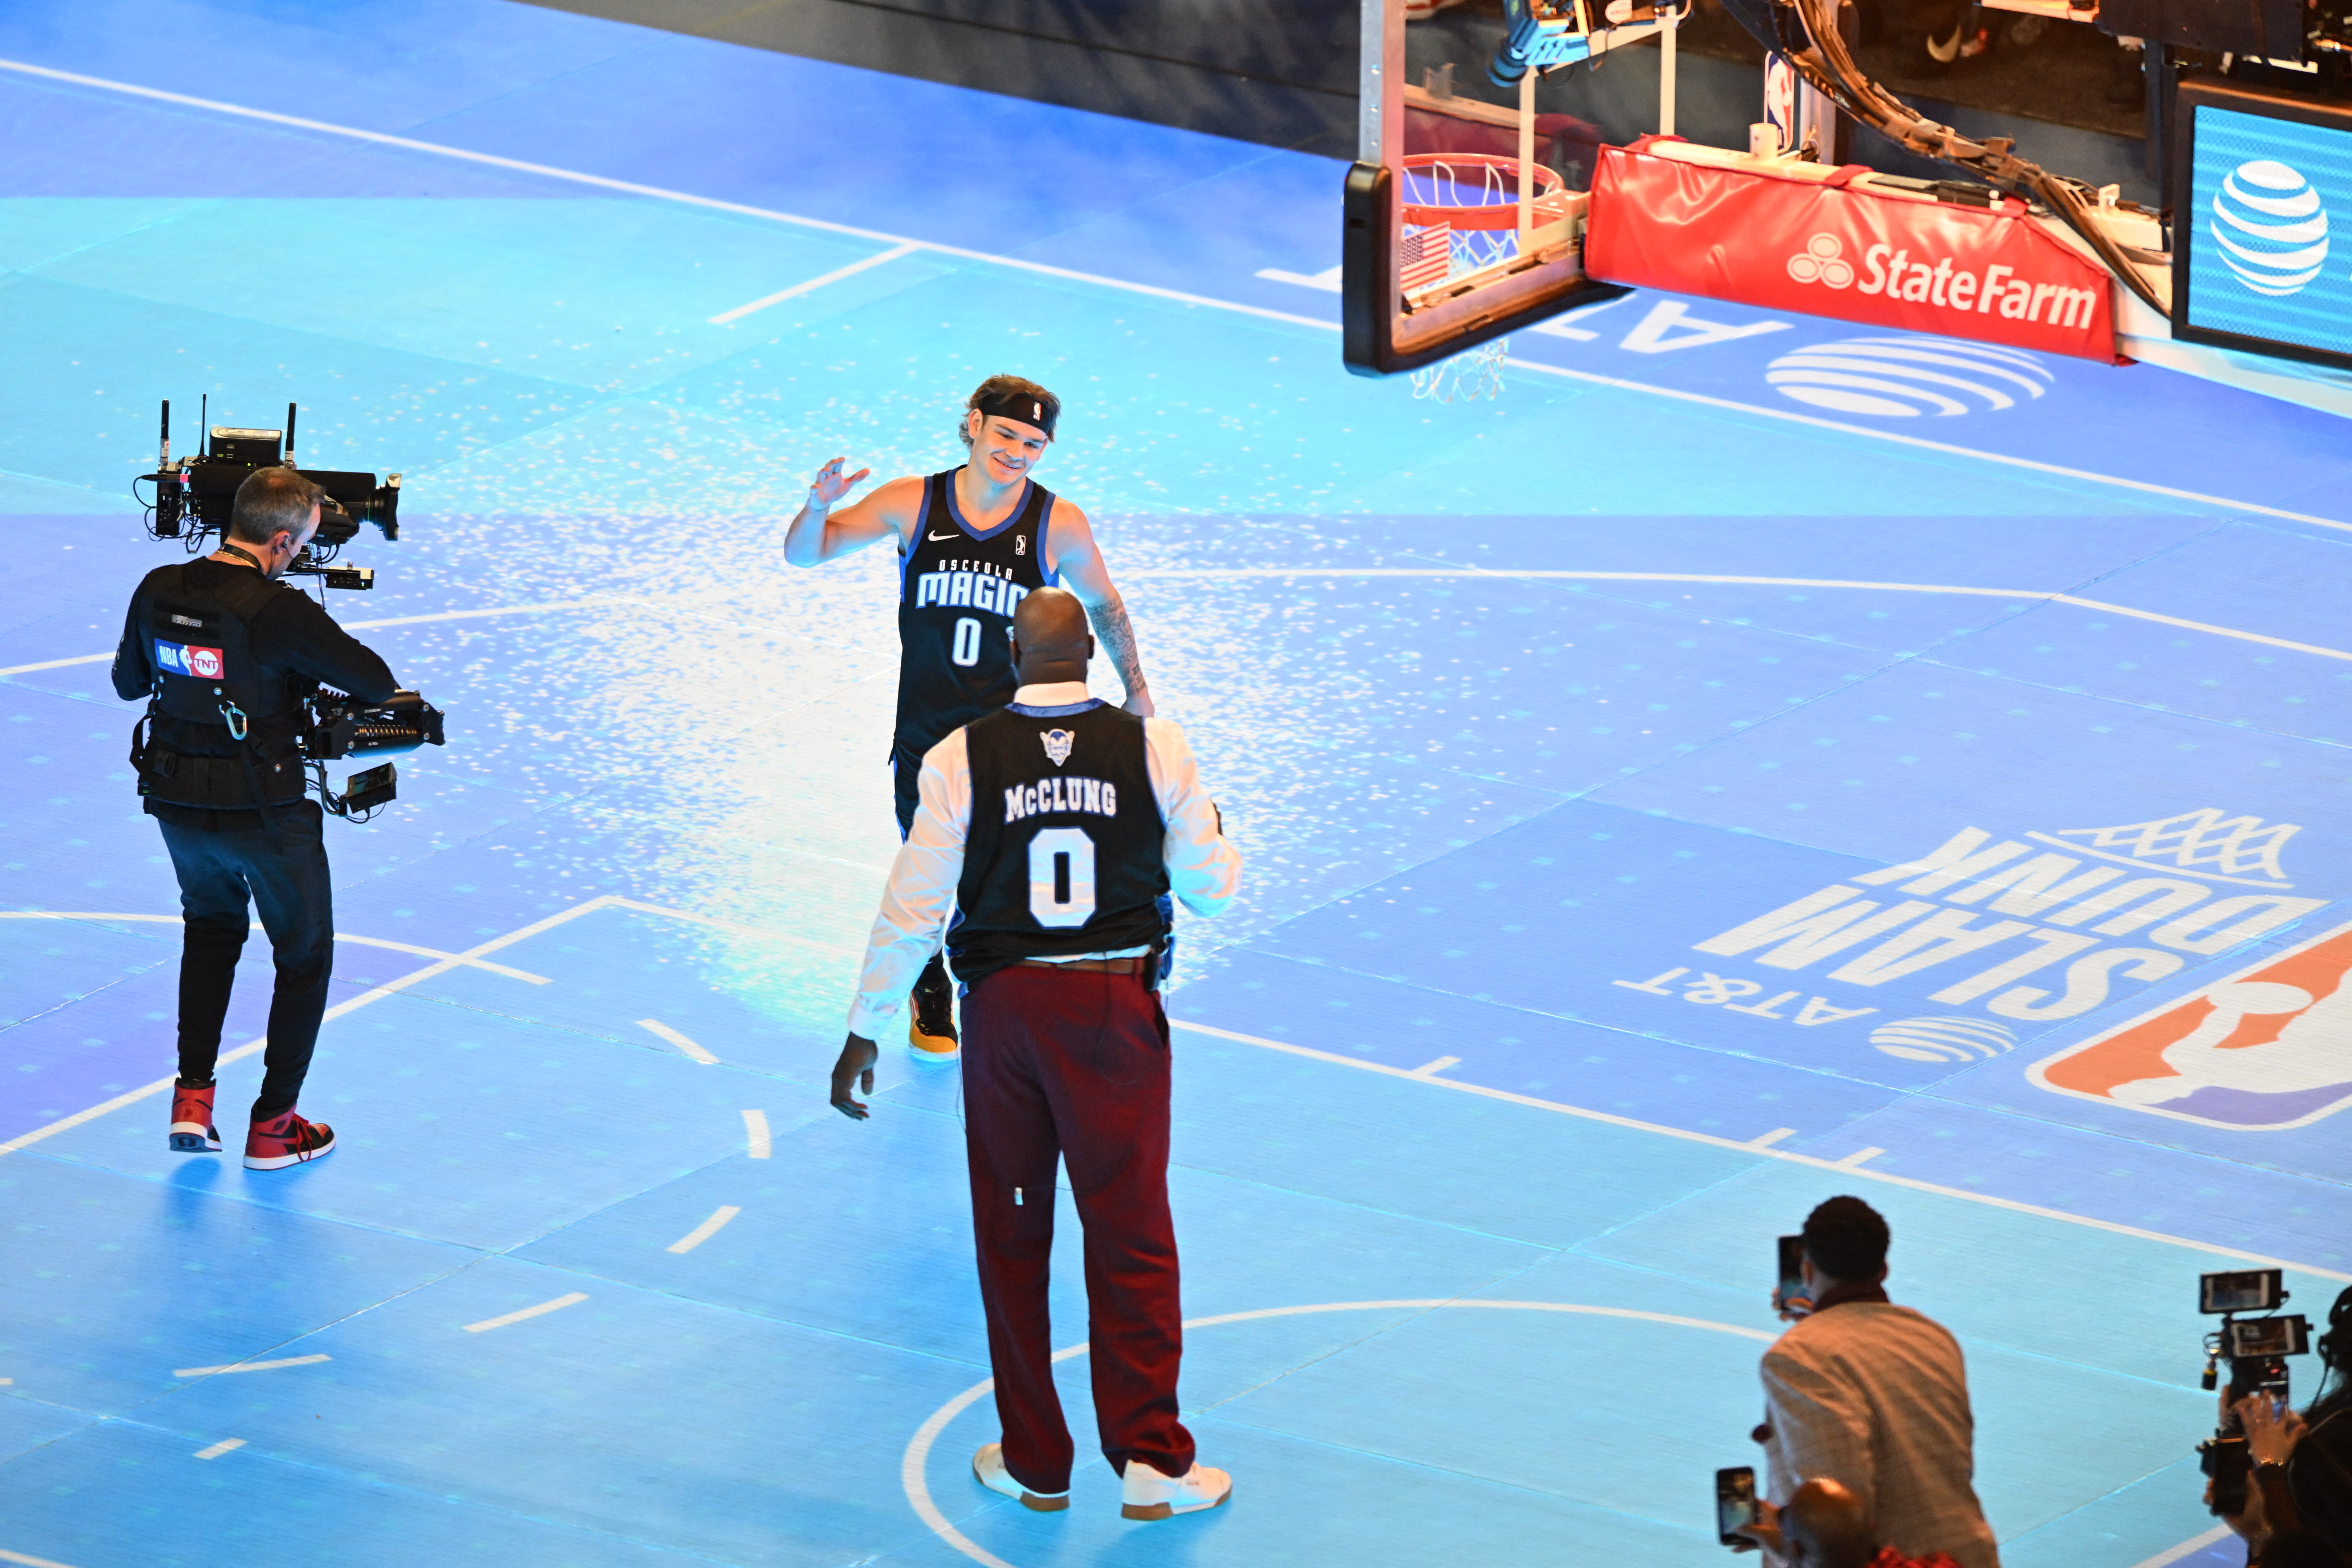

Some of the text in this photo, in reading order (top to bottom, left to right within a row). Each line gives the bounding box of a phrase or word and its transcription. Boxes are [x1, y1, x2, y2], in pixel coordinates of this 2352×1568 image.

[916, 570, 1030, 618] MAGIC
[939, 560, 1013, 581] OSCEOLA
[159, 645, 178, 667] NBA
[194, 658, 218, 669] TNT
[952, 616, 982, 667] 0
[1004, 775, 1117, 825] McCLUNG
[1028, 826, 1098, 930] 0
[1847, 826, 2332, 956] DUNK
[1691, 884, 2184, 1020] SLAM
[1612, 967, 1880, 1026] AT&T
